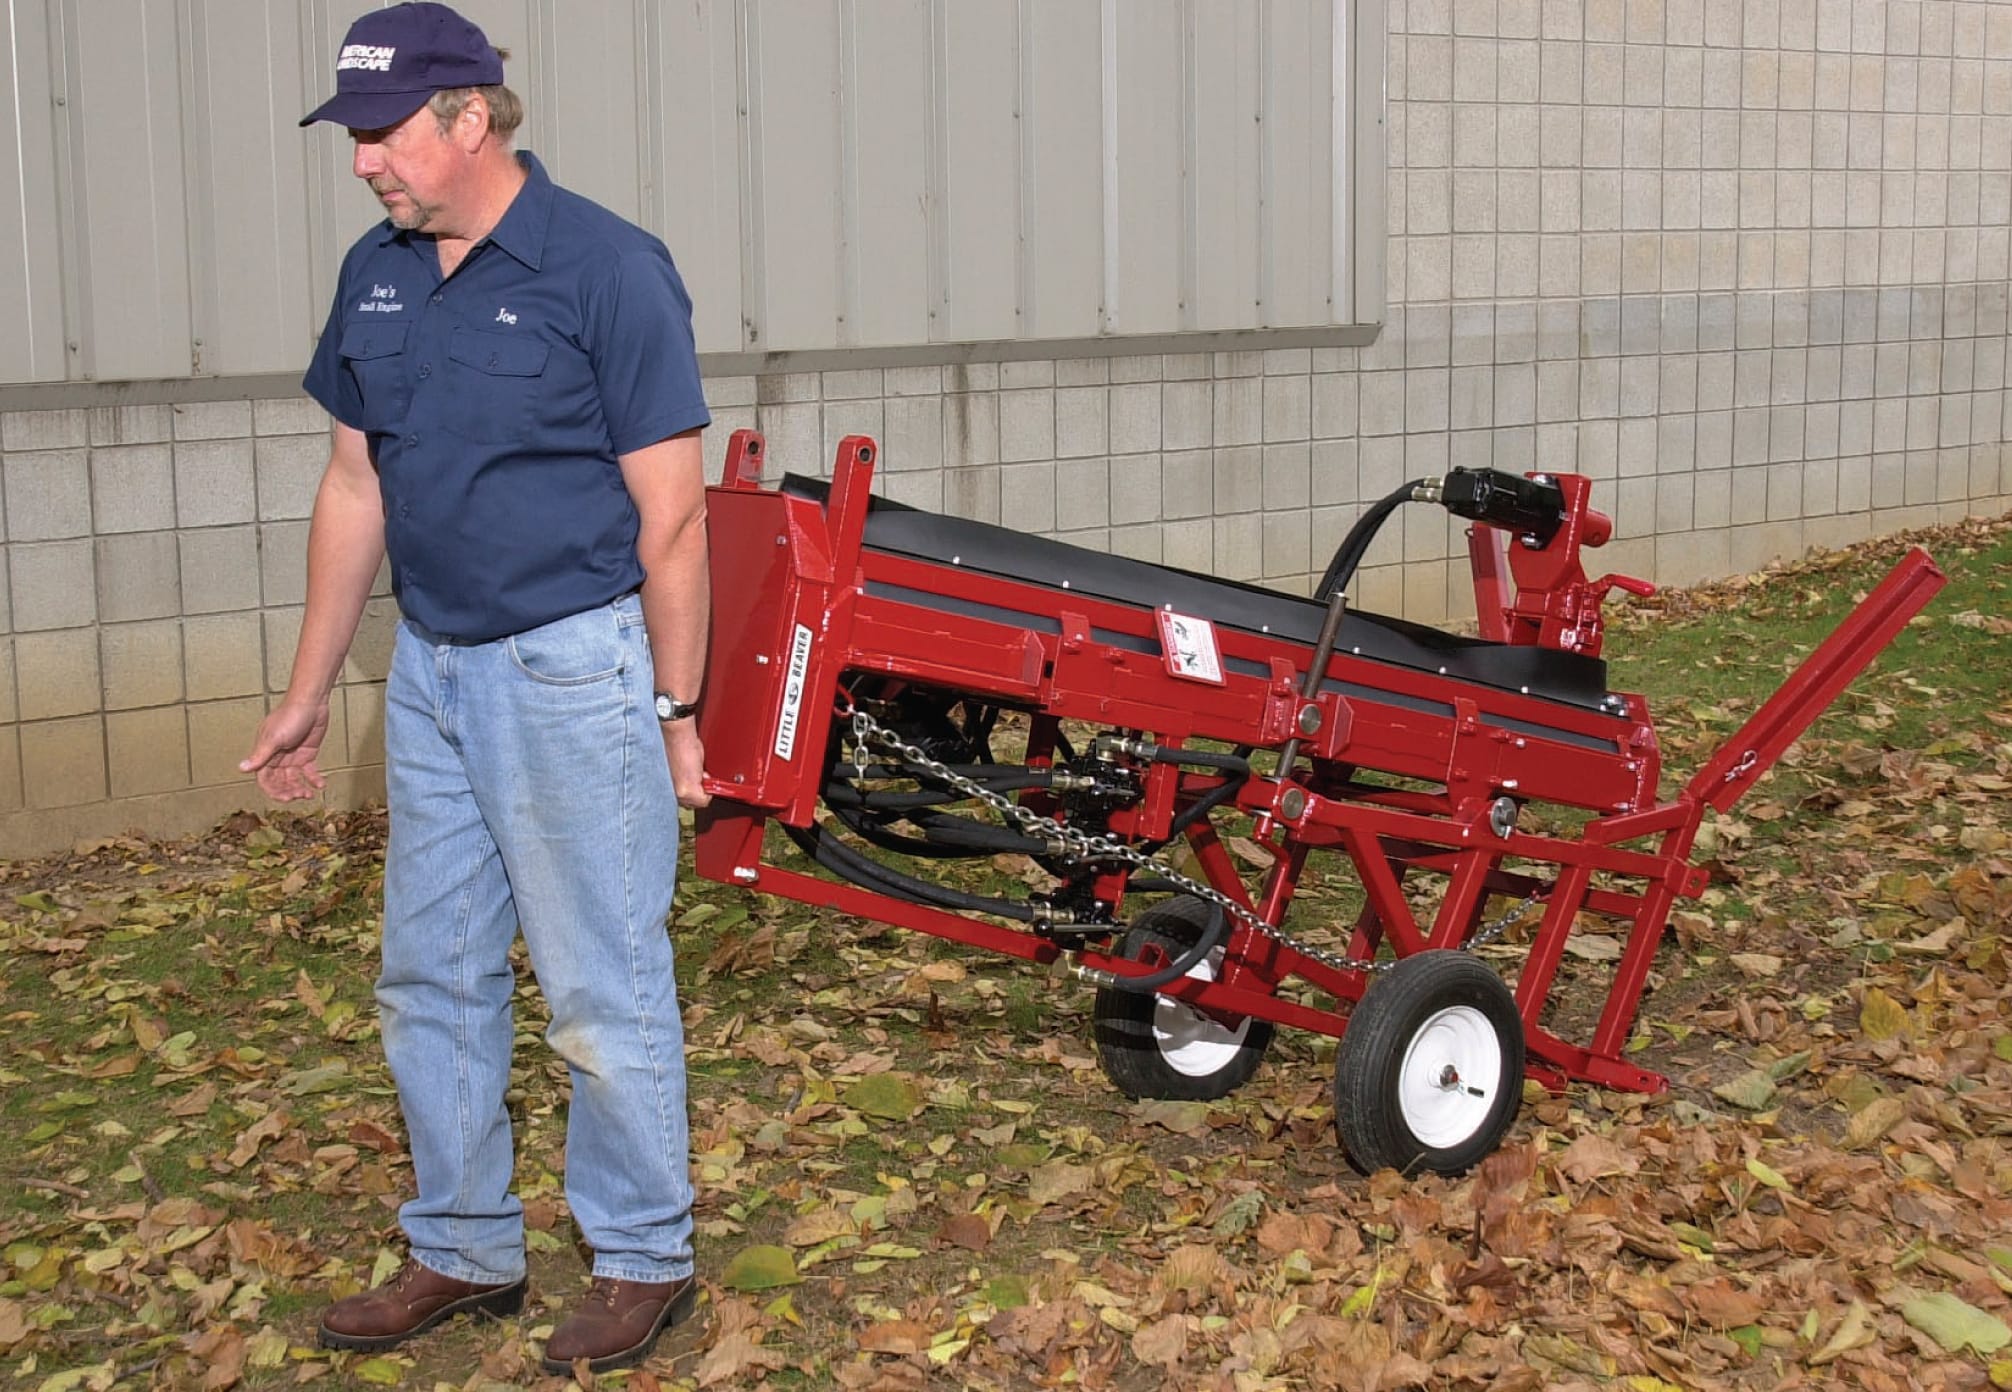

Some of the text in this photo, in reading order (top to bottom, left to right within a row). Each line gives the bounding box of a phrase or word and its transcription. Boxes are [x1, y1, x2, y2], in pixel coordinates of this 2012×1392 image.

[370, 284, 397, 299] Joe's
[376, 302, 403, 313] Engine
[495, 307, 518, 325] Joe
[779, 631, 808, 754] LITTLE BEAVER
